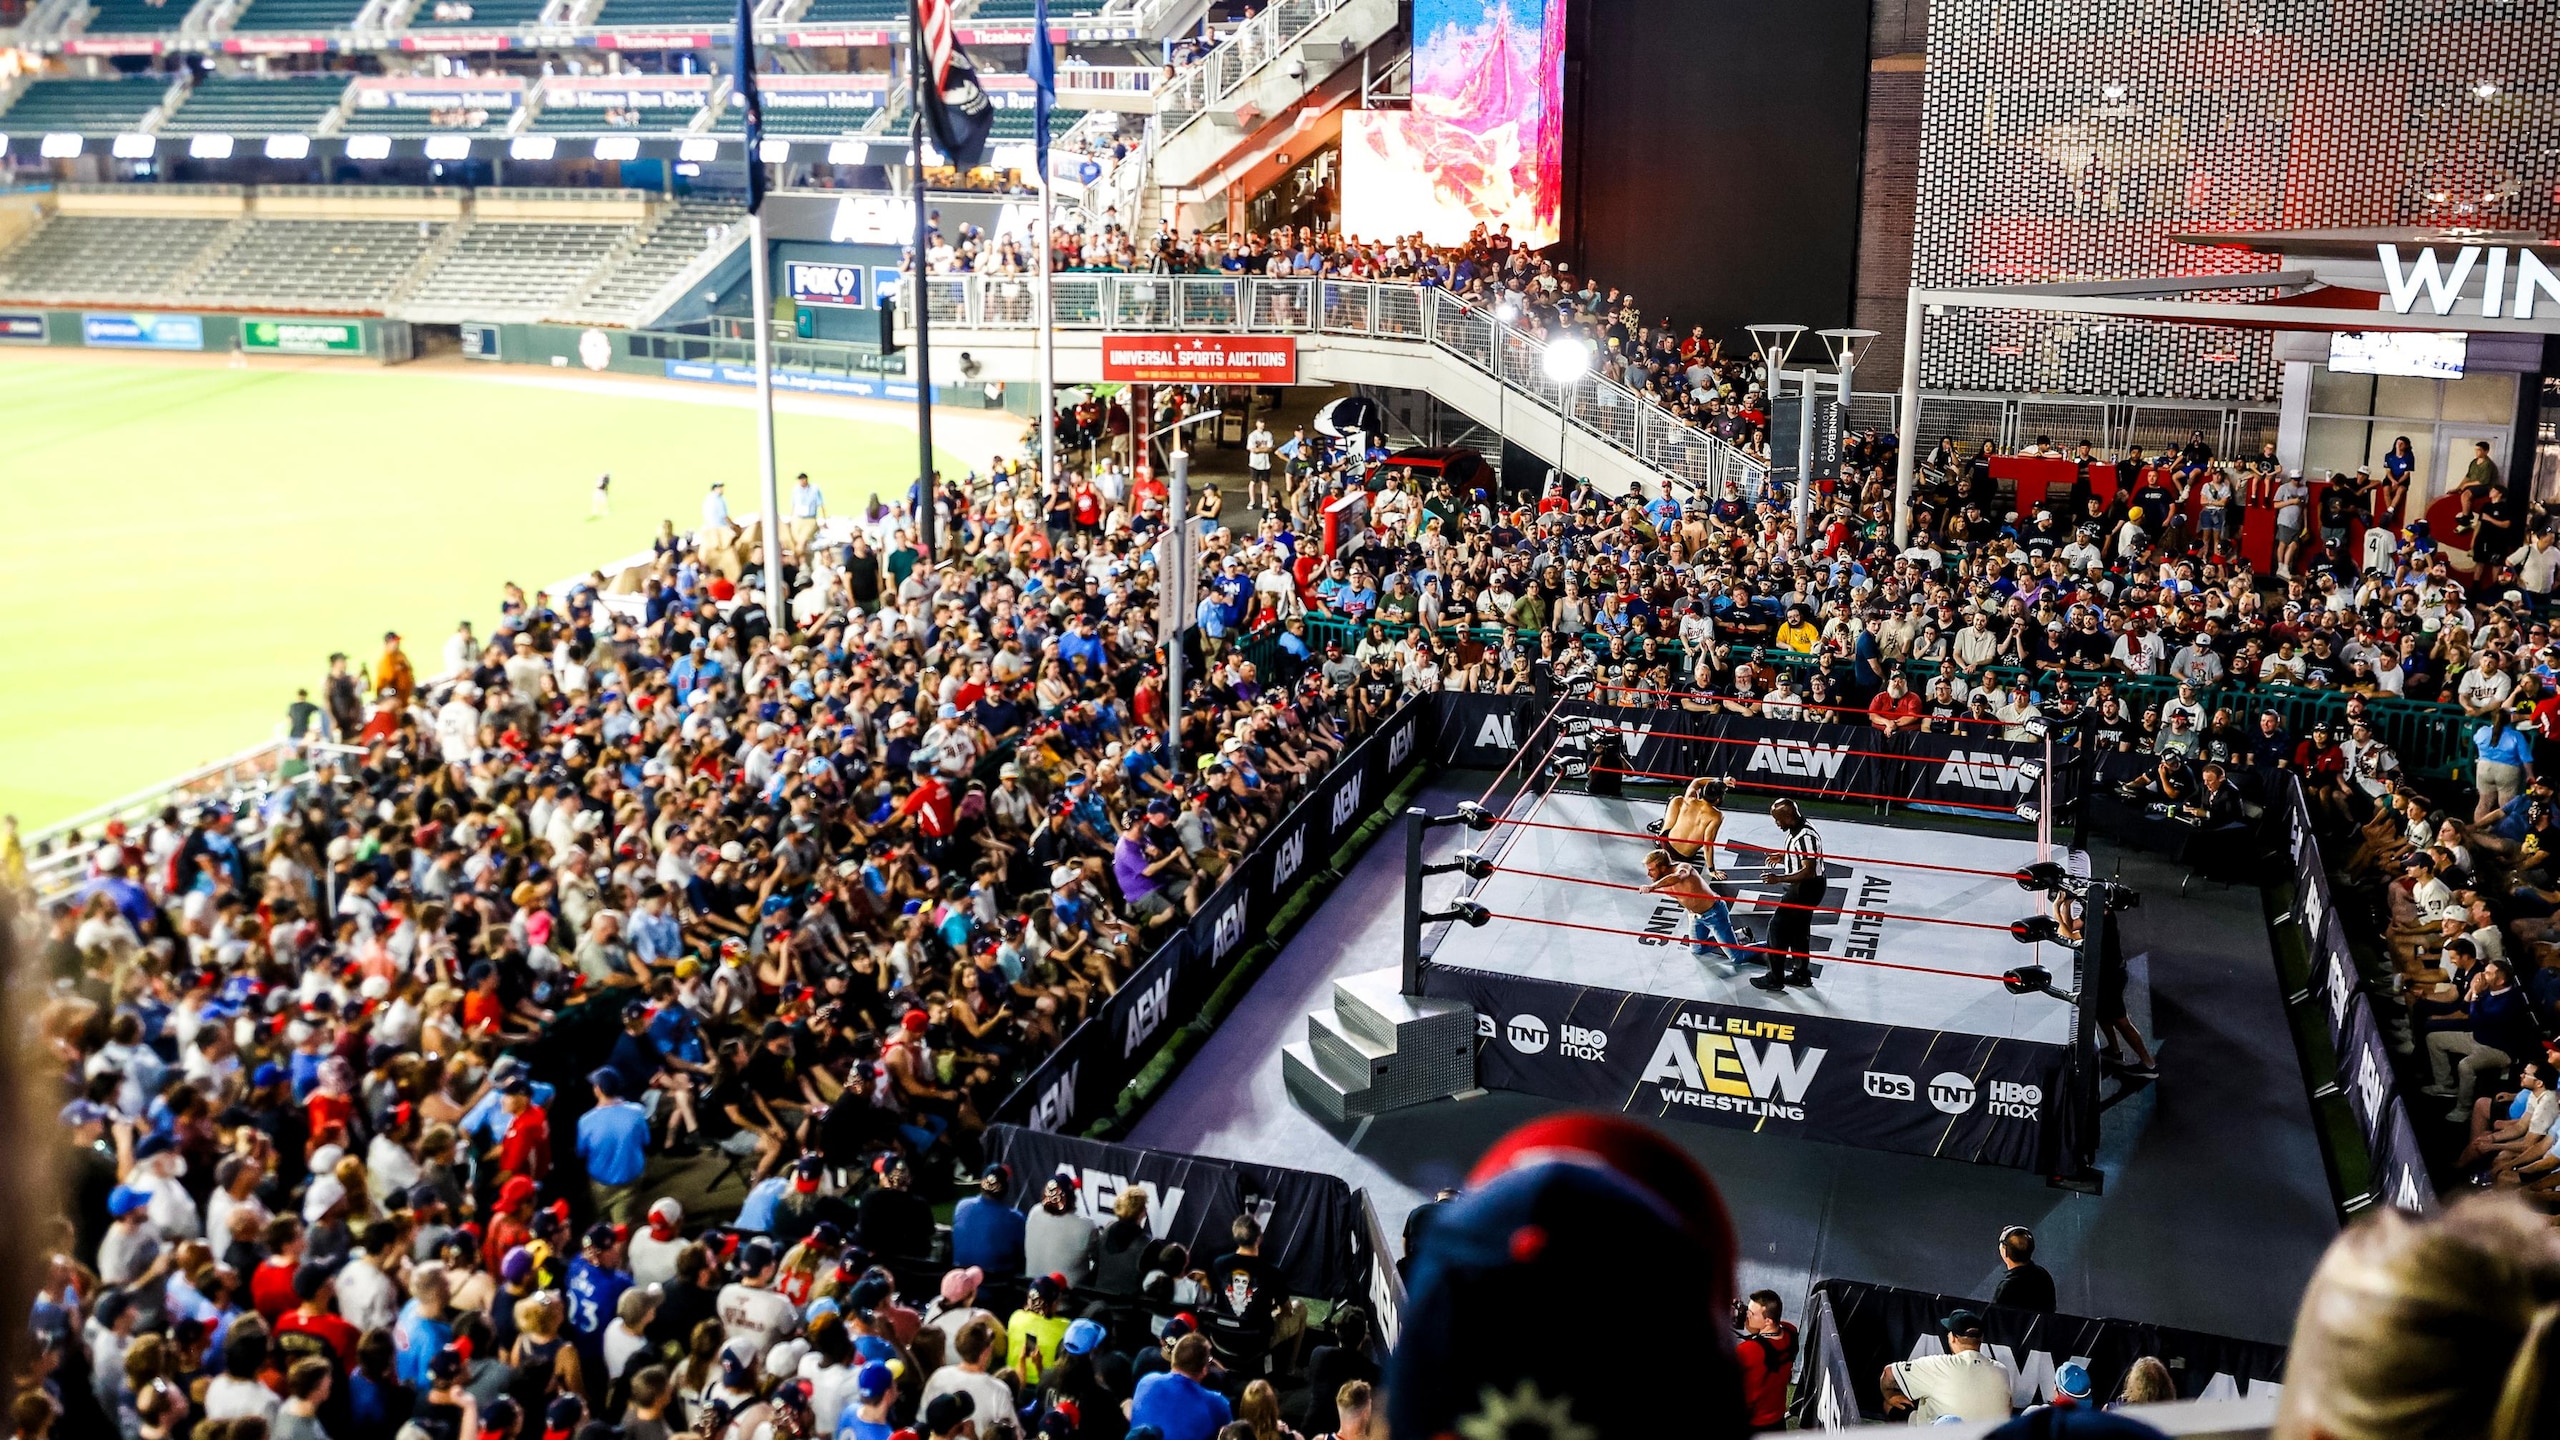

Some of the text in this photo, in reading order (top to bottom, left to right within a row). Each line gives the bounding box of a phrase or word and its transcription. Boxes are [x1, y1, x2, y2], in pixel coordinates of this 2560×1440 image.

[794, 266, 838, 295] FOX
[837, 268, 853, 295] 9
[1110, 350, 1286, 367] UNIVERSAL SPORTS AUCTIONS
[1820, 403, 1829, 462] INDUSTRIES
[1827, 400, 1839, 463] WINNEBAGO
[2369, 537, 2377, 552] 4
[1571, 682, 1594, 696] AEW
[1568, 720, 1590, 734] AEW
[2025, 720, 2048, 737] AEW
[1388, 719, 1416, 773] AEW
[1746, 737, 1850, 779] AEW
[1565, 762, 1587, 776] AEW
[1936, 750, 2036, 793] AEW
[2019, 762, 2043, 779] AEW
[1331, 769, 1363, 834] AEW
[2016, 805, 2041, 822] AEW
[1272, 823, 1306, 894] AEW
[1857, 875, 1892, 907] ALL
[1211, 887, 1249, 968] AEW
[1845, 908, 1885, 960] ELITE
[1124, 968, 1172, 1059] AEW
[1676, 1012, 1795, 1041] ALL ELITE
[1561, 1023, 1608, 1050] HBO
[1560, 1042, 1605, 1062] max
[1640, 1027, 1829, 1104] AEW
[1029, 1060, 1079, 1133] AEW
[1868, 1074, 1911, 1097] tbs
[1990, 1080, 2043, 1106] HBO
[1660, 1087, 1805, 1121] WRESTLING
[1988, 1101, 2038, 1122] max
